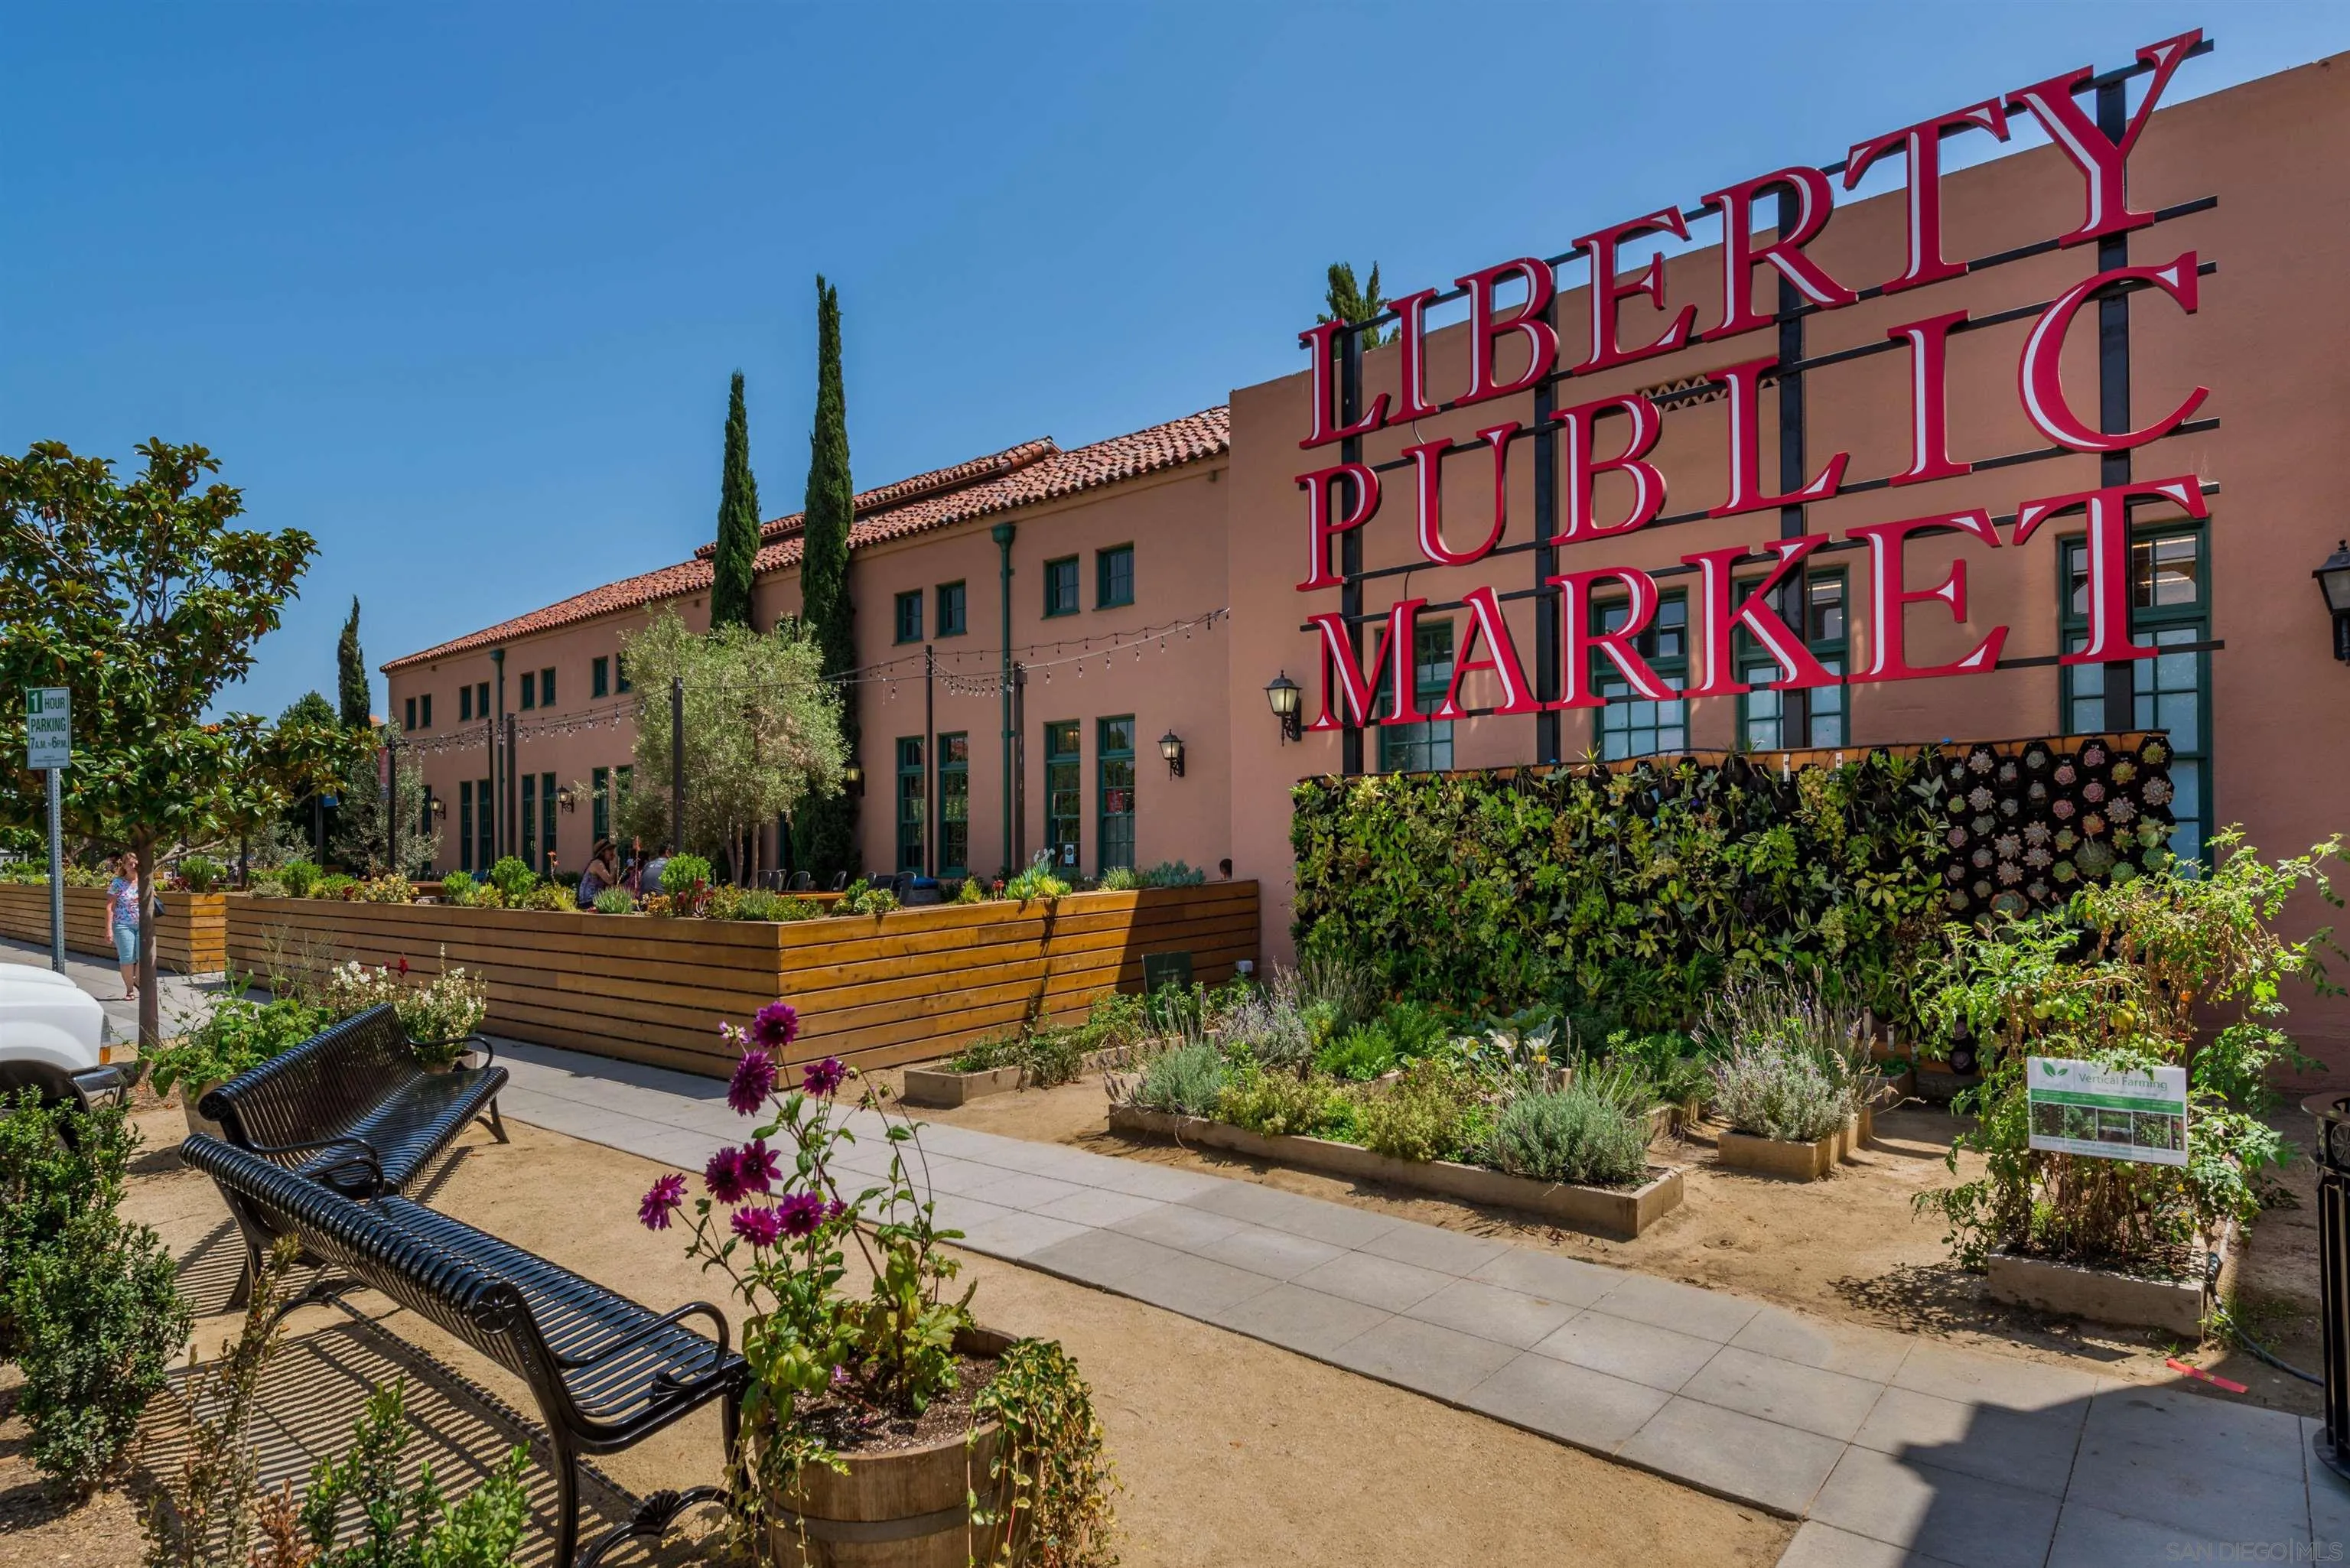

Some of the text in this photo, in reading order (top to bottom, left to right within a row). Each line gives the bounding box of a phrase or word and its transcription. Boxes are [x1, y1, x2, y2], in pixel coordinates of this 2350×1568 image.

[1297, 28, 2203, 448] LIBERTY
[1294, 250, 2210, 591] PUBLIC
[1307, 474, 2208, 732] MARKET
[31, 692, 66, 712] 1 HOUR
[31, 717, 67, 733] PARKING
[2078, 1072, 2119, 1085] Vertical
[2121, 1076, 2169, 1091] Farming
